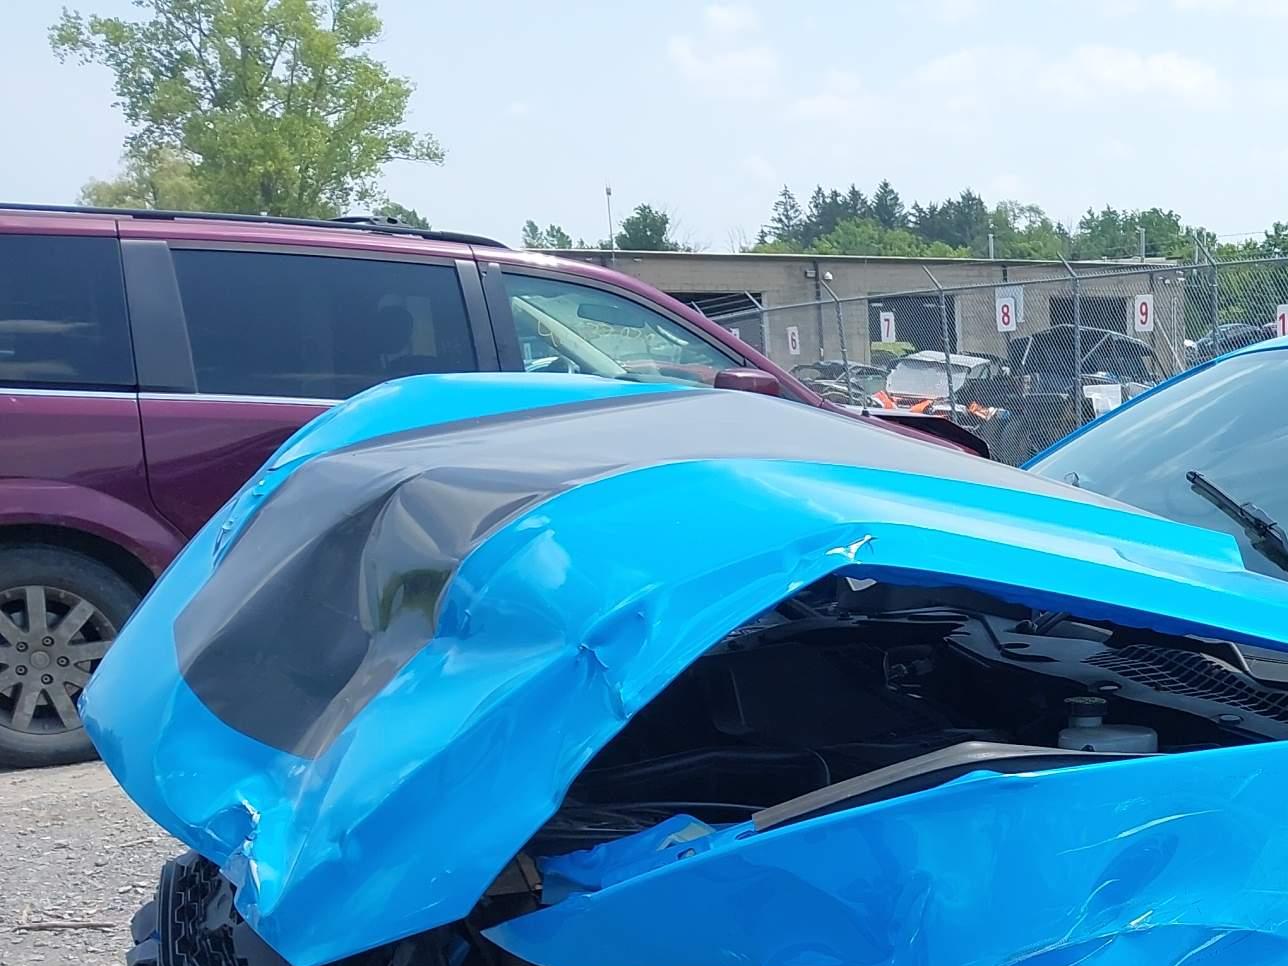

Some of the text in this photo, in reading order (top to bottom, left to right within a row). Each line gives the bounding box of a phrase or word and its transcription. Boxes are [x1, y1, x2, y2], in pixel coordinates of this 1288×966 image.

[1001, 304, 1011, 326] 8
[1139, 302, 1149, 325] 9
[884, 318, 891, 338] 7
[790, 333, 797, 350] 6
